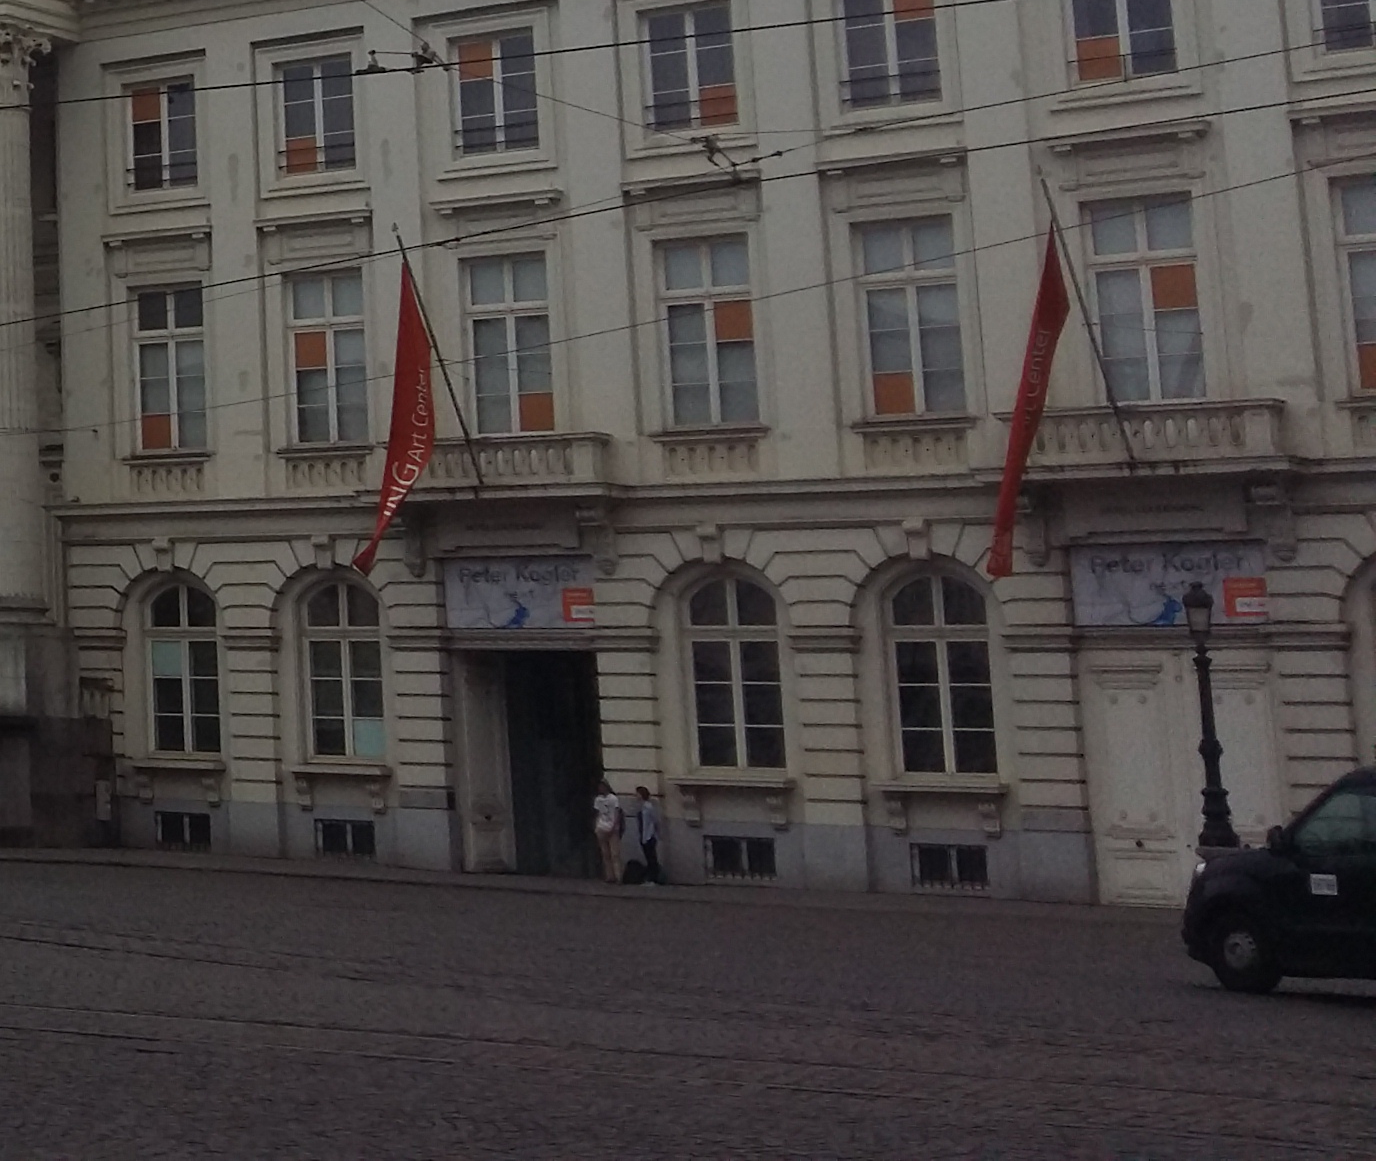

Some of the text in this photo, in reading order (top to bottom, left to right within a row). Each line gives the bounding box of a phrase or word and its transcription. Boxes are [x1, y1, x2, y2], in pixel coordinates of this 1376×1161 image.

[411, 367, 429, 427] Center
[407, 433, 427, 463] Art
[458, 563, 580, 587] Peter Kogler
[1090, 550, 1244, 575] Peter Kogler
